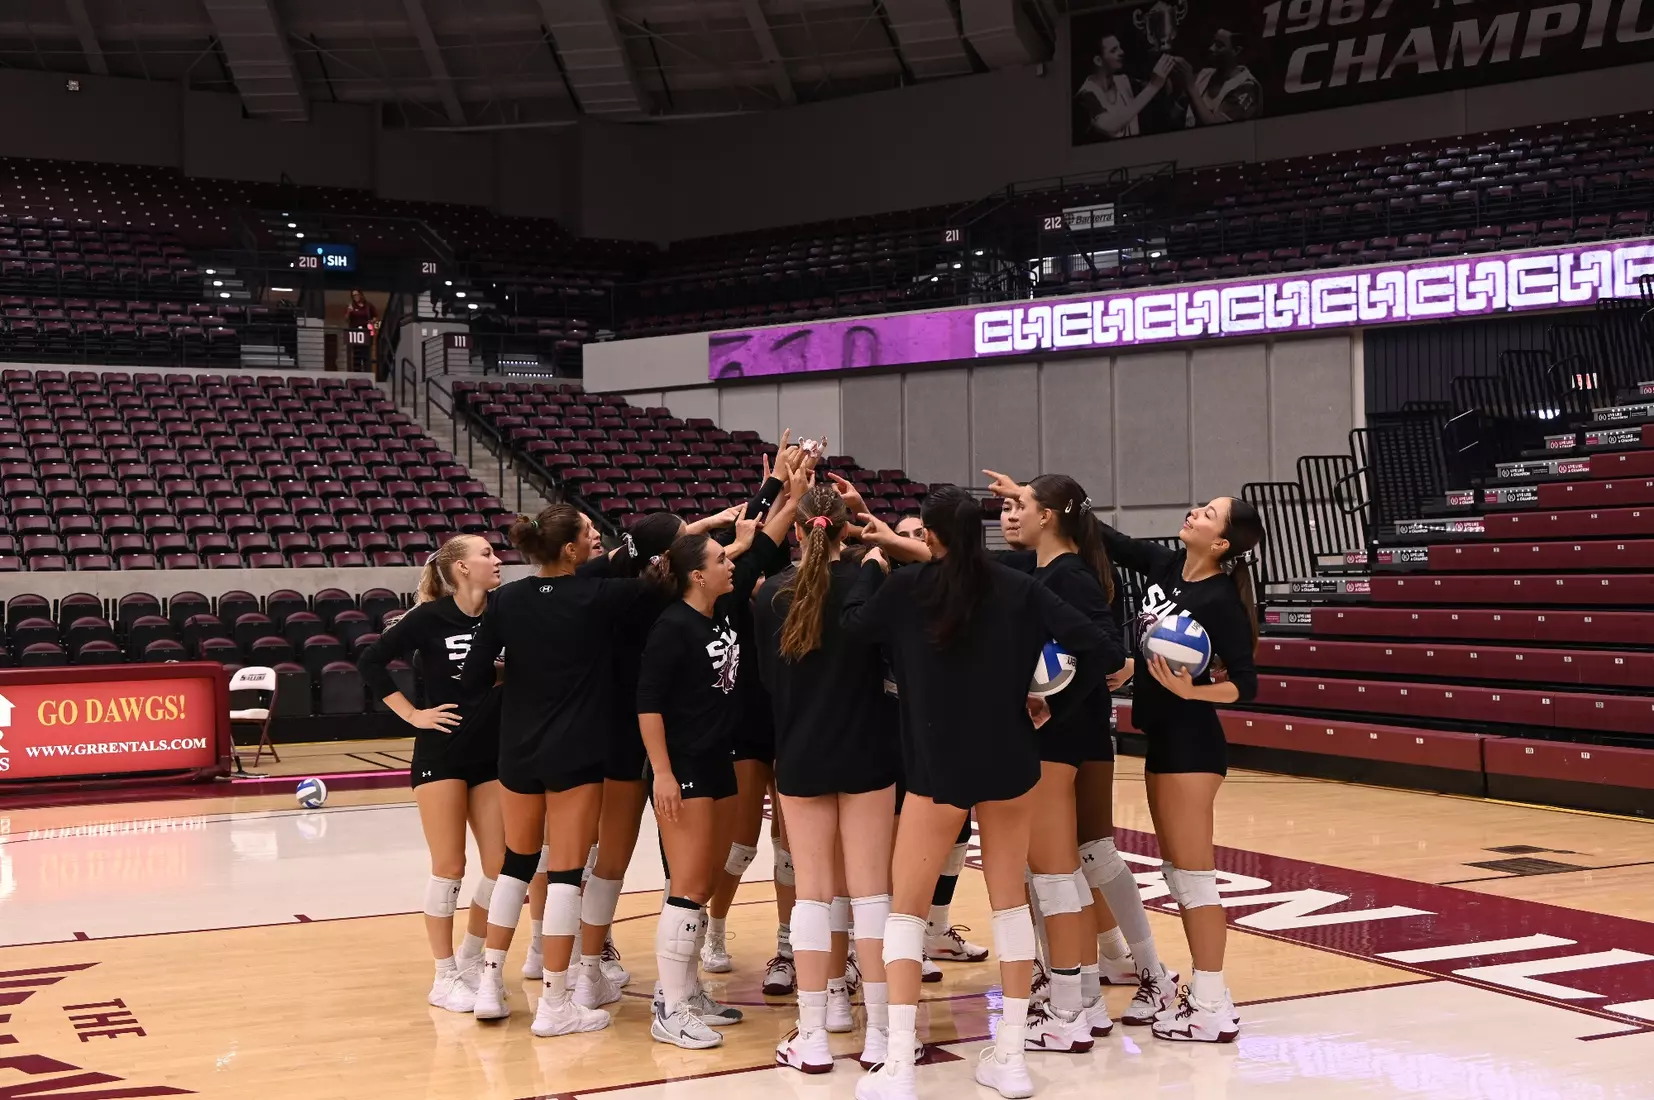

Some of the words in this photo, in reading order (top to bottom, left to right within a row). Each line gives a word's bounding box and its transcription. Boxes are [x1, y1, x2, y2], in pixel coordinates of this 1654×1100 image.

[1044, 217, 1062, 230] 212
[945, 230, 959, 242] 211
[299, 256, 317, 268] 210
[327, 255, 347, 267] SIH
[422, 262, 436, 274] 211
[349, 331, 365, 344] 110
[454, 336, 466, 348] 111
[37, 699, 78, 726] GO
[85, 694, 186, 724] DAWGS!
[25, 737, 207, 758] WWW.GRRENTALS.COM
[62, 998, 147, 1042] THE
